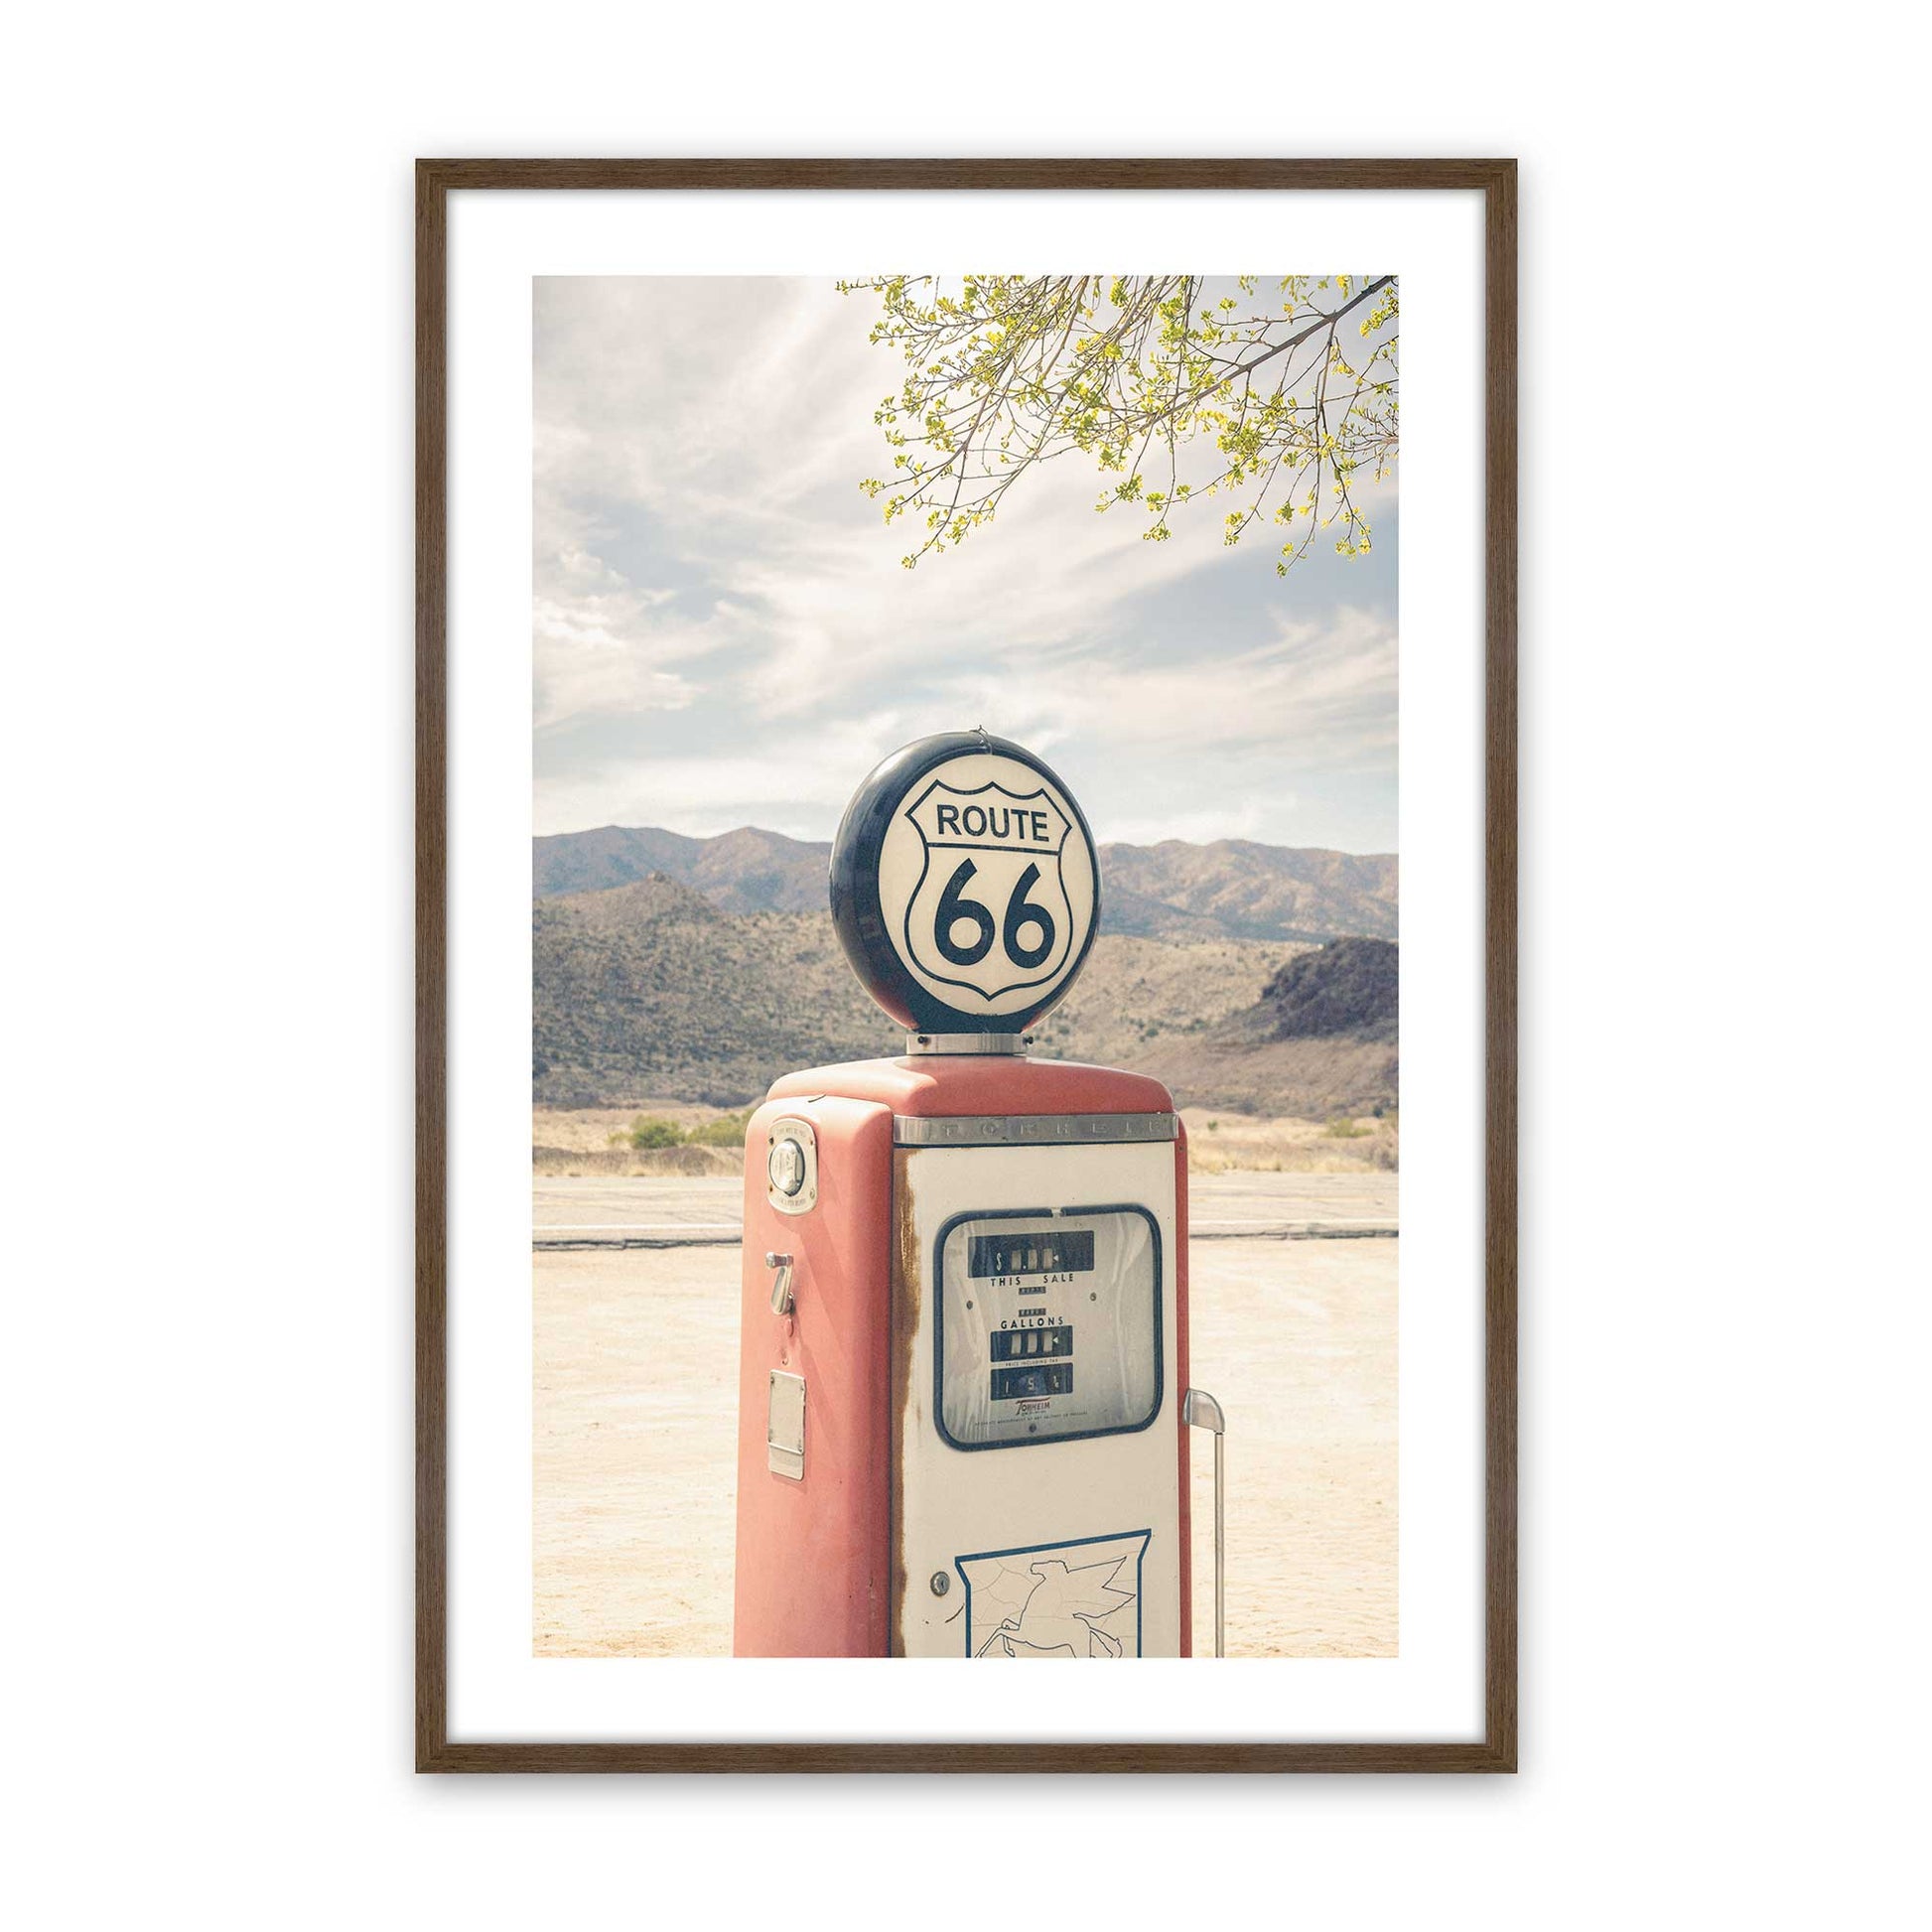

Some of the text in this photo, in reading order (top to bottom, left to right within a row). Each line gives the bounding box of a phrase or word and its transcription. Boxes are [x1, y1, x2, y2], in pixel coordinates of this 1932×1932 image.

[936, 804, 1050, 843] ROUTE
[934, 858, 1056, 969] 66
[991, 1273, 1074, 1287] THIS SALE
[1001, 1316, 1064, 1329] GALLONS
